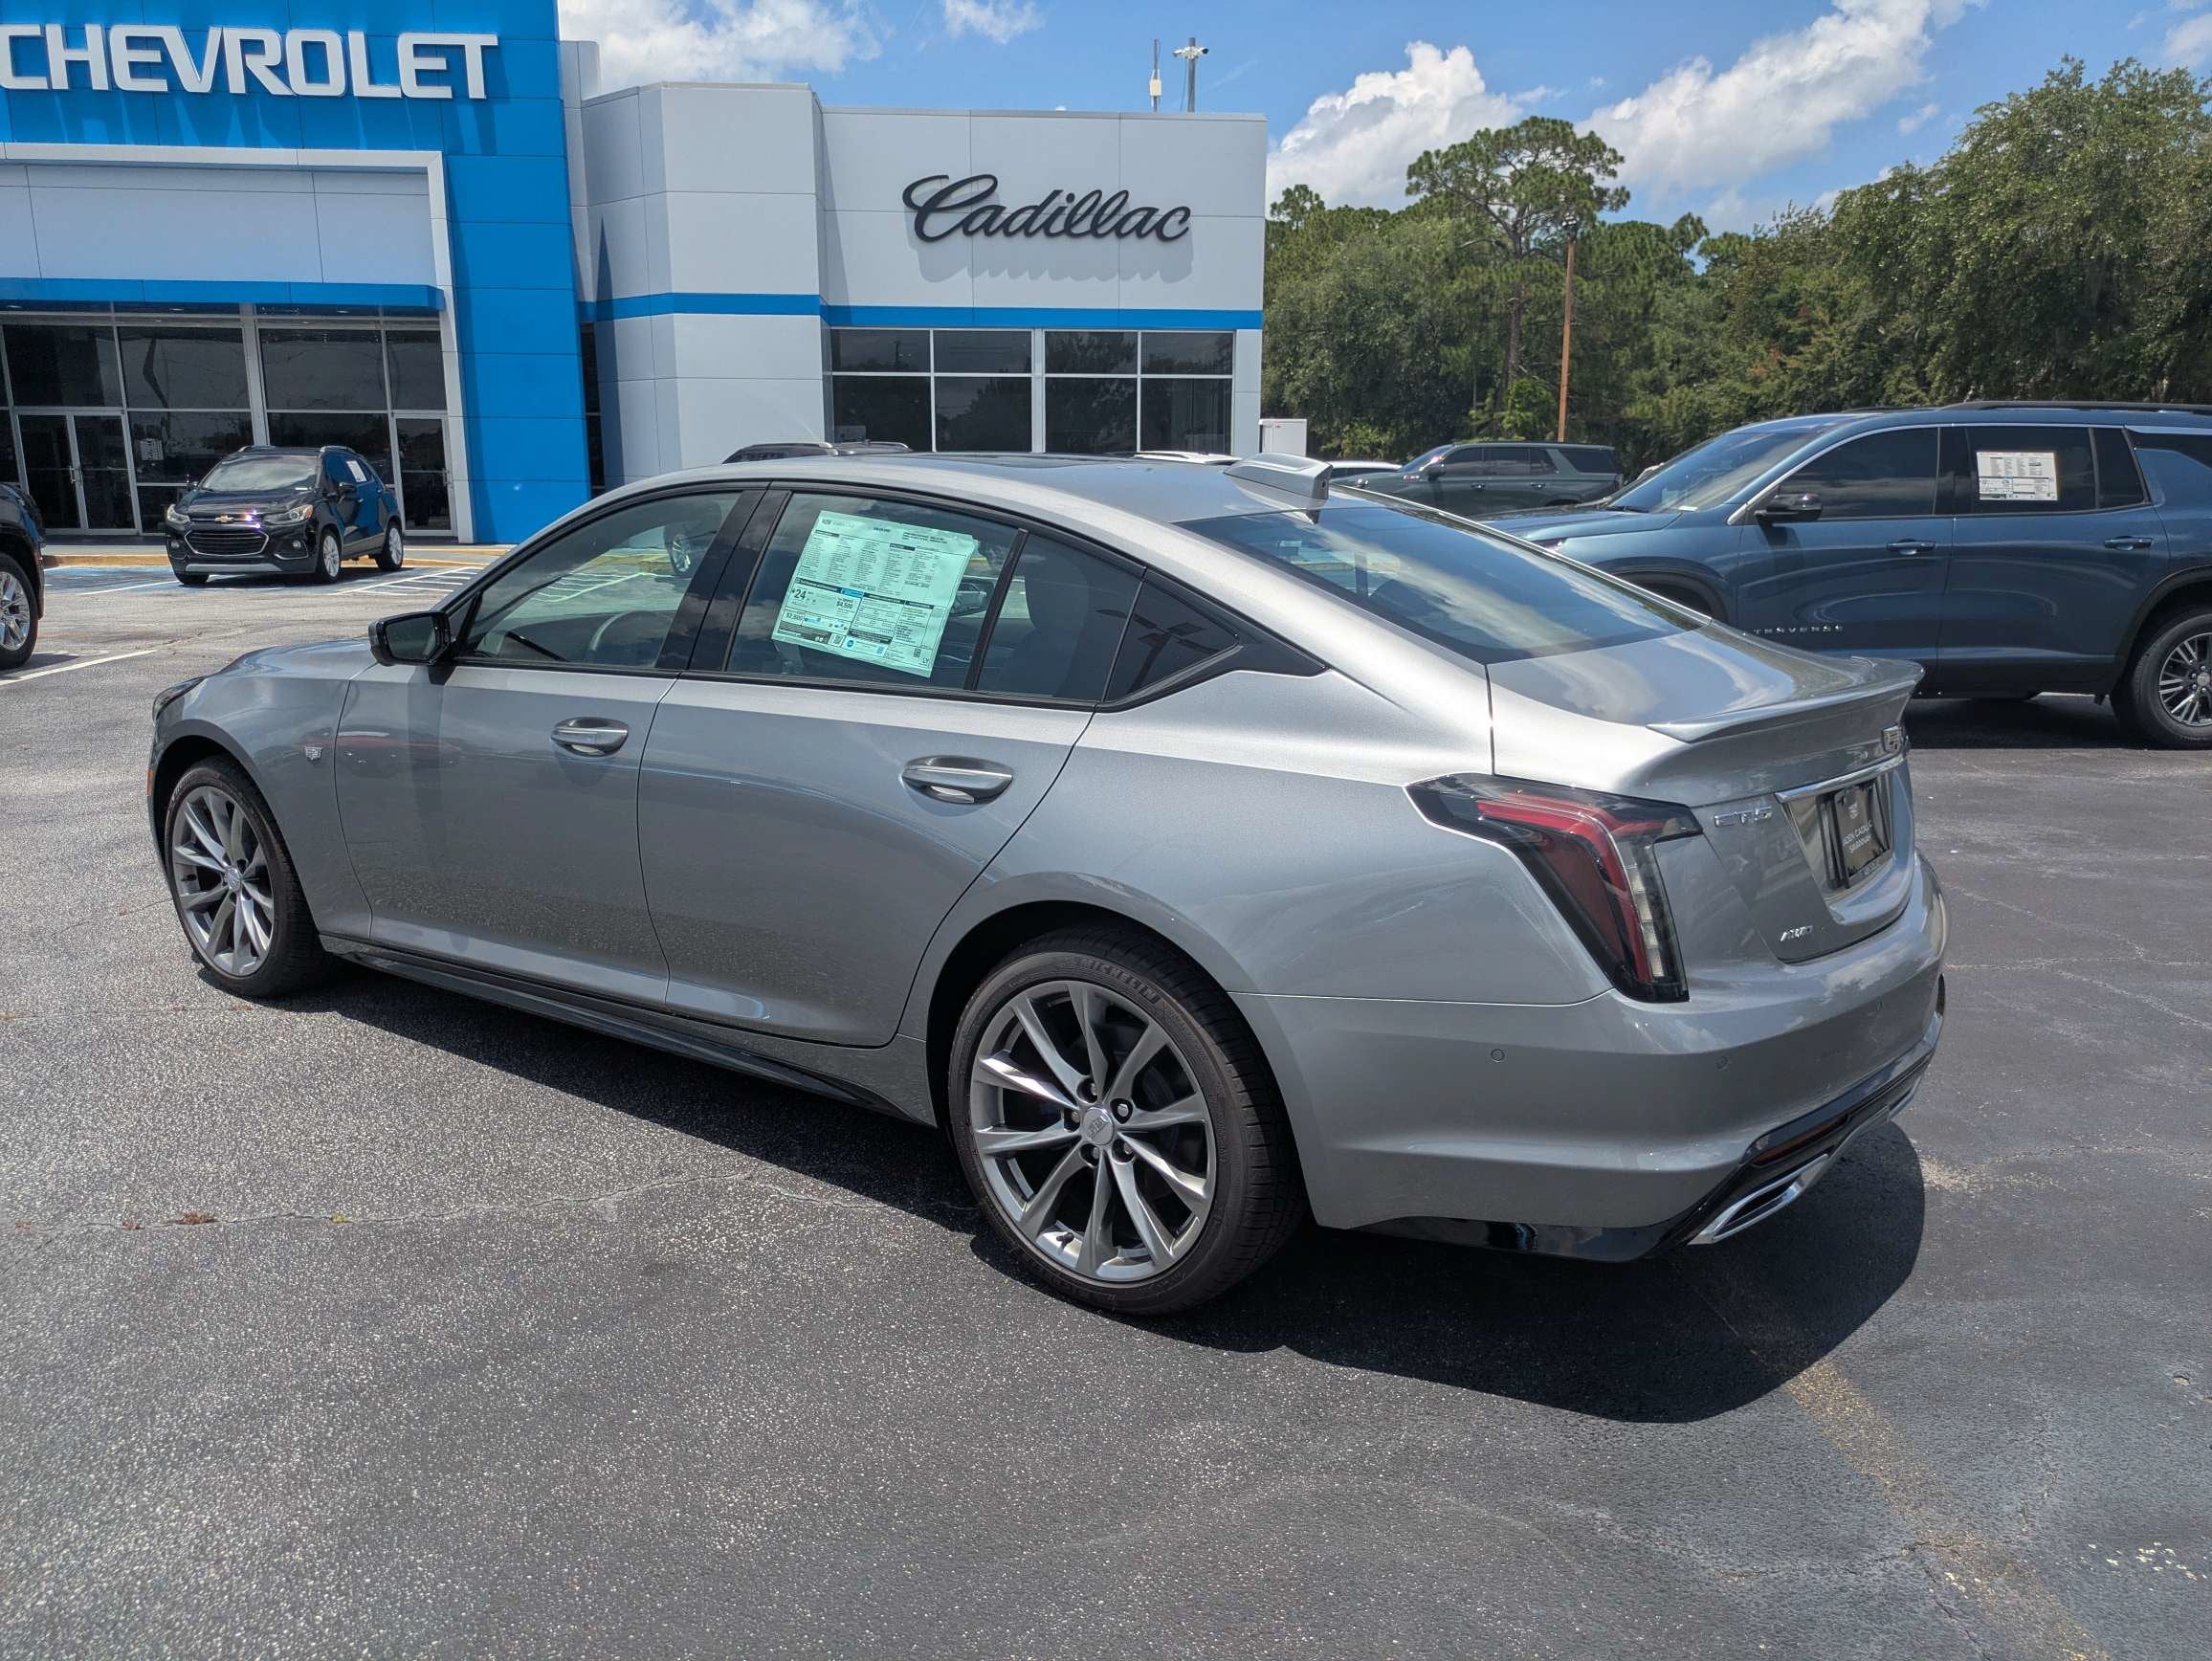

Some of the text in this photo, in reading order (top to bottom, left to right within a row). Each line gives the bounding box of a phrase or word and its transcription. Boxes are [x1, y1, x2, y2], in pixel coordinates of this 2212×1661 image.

[0, 24, 499, 100] CHEVROLET
[902, 174, 1192, 243] Cadillac
[793, 588, 807, 601] 24
